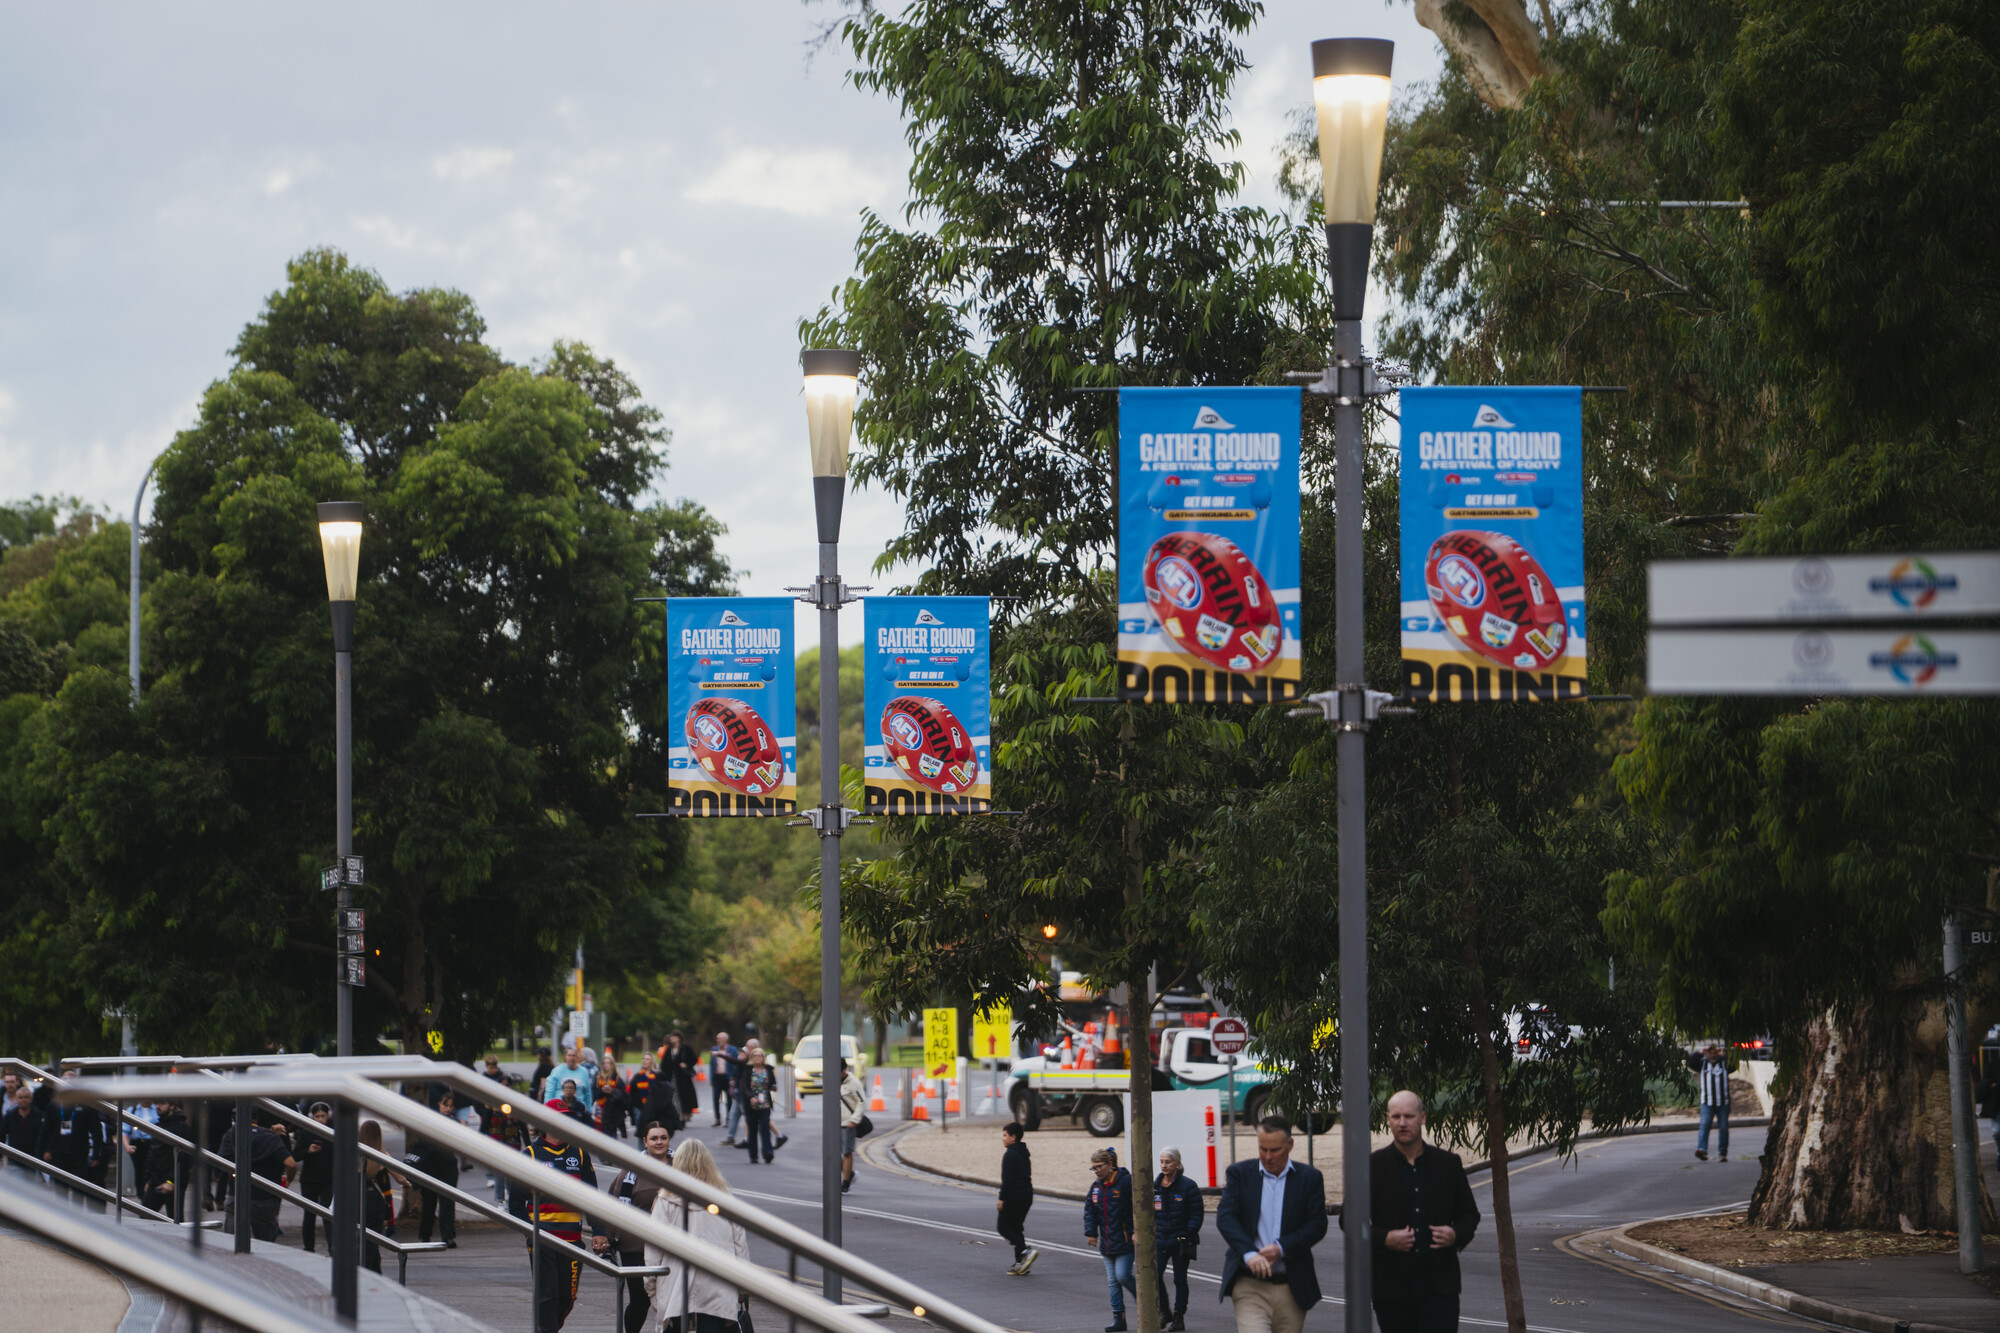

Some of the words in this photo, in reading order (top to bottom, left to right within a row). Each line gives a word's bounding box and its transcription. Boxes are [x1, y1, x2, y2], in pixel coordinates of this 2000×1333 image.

[1202, 415, 1218, 423] AFL
[1482, 413, 1498, 422] AFL
[1139, 433, 1211, 462] GATHER
[1215, 432, 1280, 461] ROUND
[1419, 432, 1492, 460] GATHER
[1496, 432, 1561, 460] ROUND
[1140, 462, 1150, 471] A
[1152, 462, 1213, 471] FESTIVAL
[1216, 462, 1234, 471] OF
[1236, 462, 1280, 471] FOOTY
[1420, 461, 1430, 470] A
[1432, 461, 1494, 470] FESTIVAL
[1497, 460, 1514, 469] OF
[1517, 460, 1561, 470] FOOTY
[1184, 496, 1200, 508] GET
[1225, 496, 1236, 508] IT
[1465, 494, 1482, 506] GET
[1507, 494, 1517, 506] IT
[1157, 562, 1195, 608] AFL
[1439, 560, 1478, 605] AFL
[682, 629, 732, 649] GATHER
[735, 628, 780, 648] ROUND
[878, 627, 928, 648] GATHER
[930, 627, 975, 647] ROUND
[714, 672, 726, 680] GET
[743, 672, 750, 680] IT
[909, 671, 921, 679] GET
[938, 671, 945, 679] IT
[696, 719, 722, 750] AFL
[892, 717, 918, 748] AFL
[727, 757, 746, 769] ADELAIDE
[923, 756, 941, 767] ADELAIDE
[329, 868, 338, 886] BUS
[1971, 931, 1998, 944] BU
[931, 1010, 948, 1022] AO
[931, 1023, 948, 1035] 1-8
[1224, 1023, 1235, 1032] NO
[933, 1037, 949, 1049] AO
[1219, 1042, 1241, 1050] ENTRY
[926, 1051, 955, 1062] 11-14
